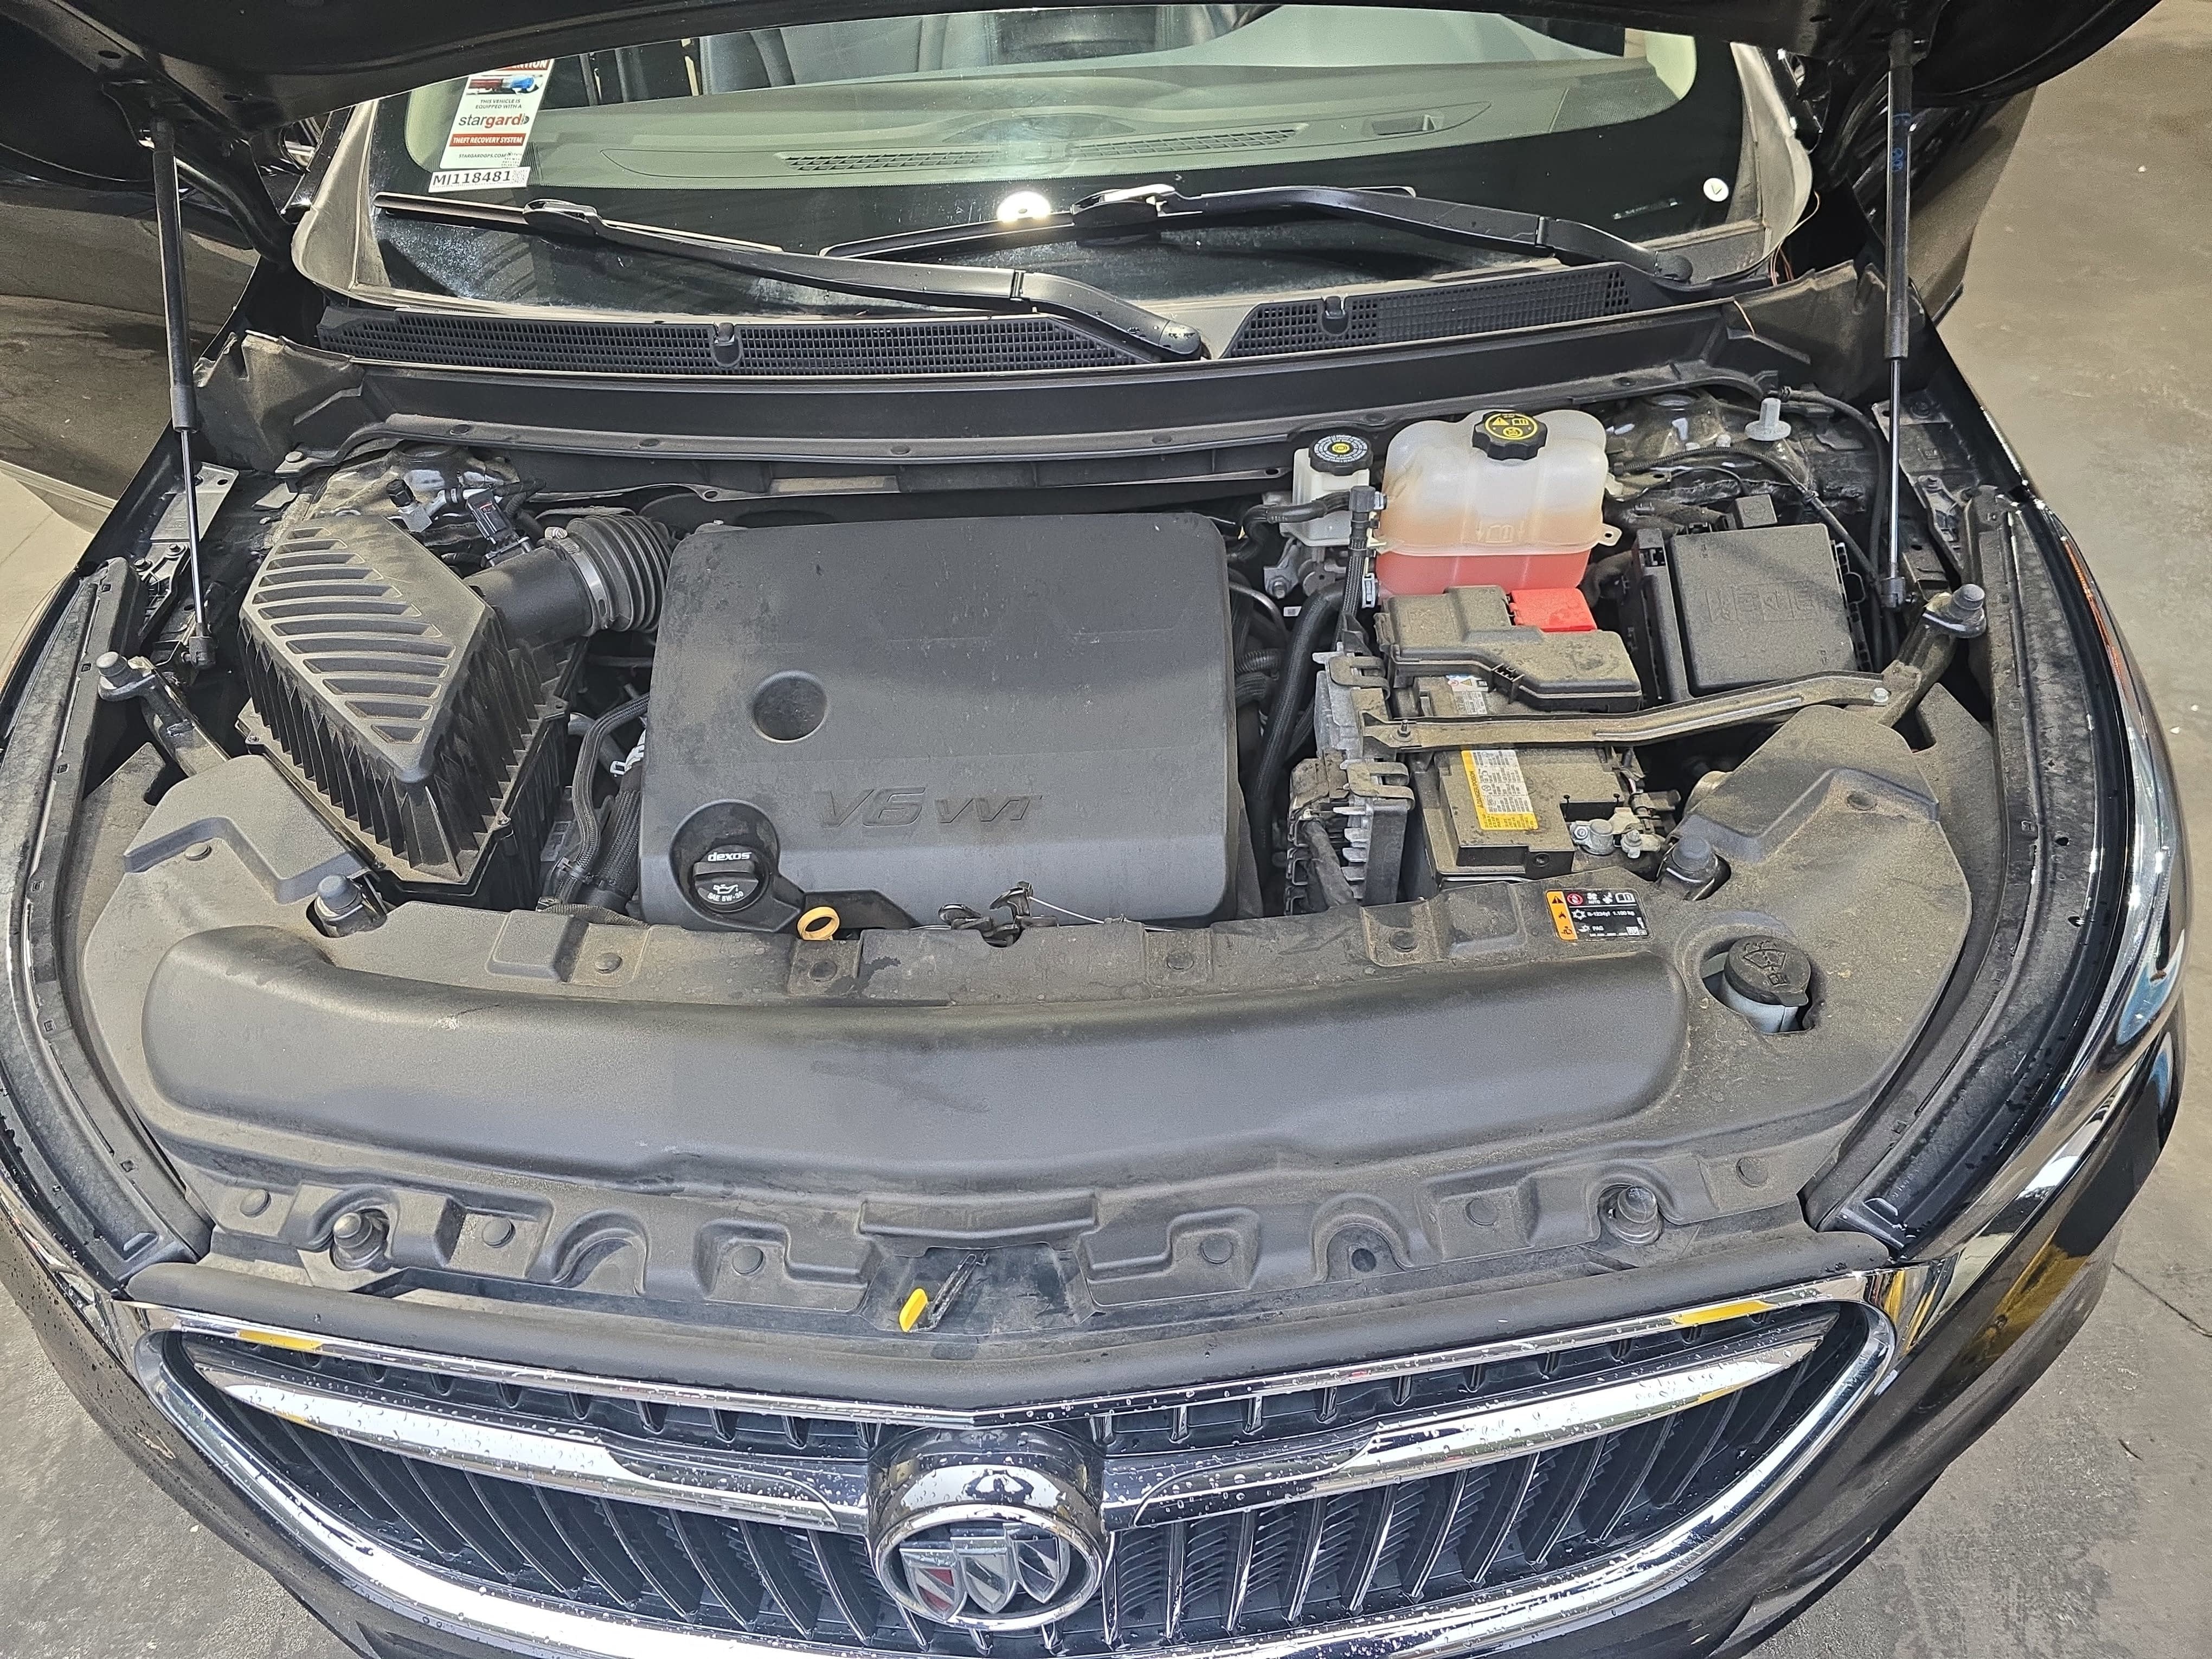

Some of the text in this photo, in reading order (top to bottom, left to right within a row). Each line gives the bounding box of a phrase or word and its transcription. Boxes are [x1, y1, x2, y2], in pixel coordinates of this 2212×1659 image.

[459, 113, 523, 128] stargard
[814, 787, 1043, 828] V6 VVT
[708, 852, 752, 861] dexos
[708, 891, 744, 902] SAE 5W-30
